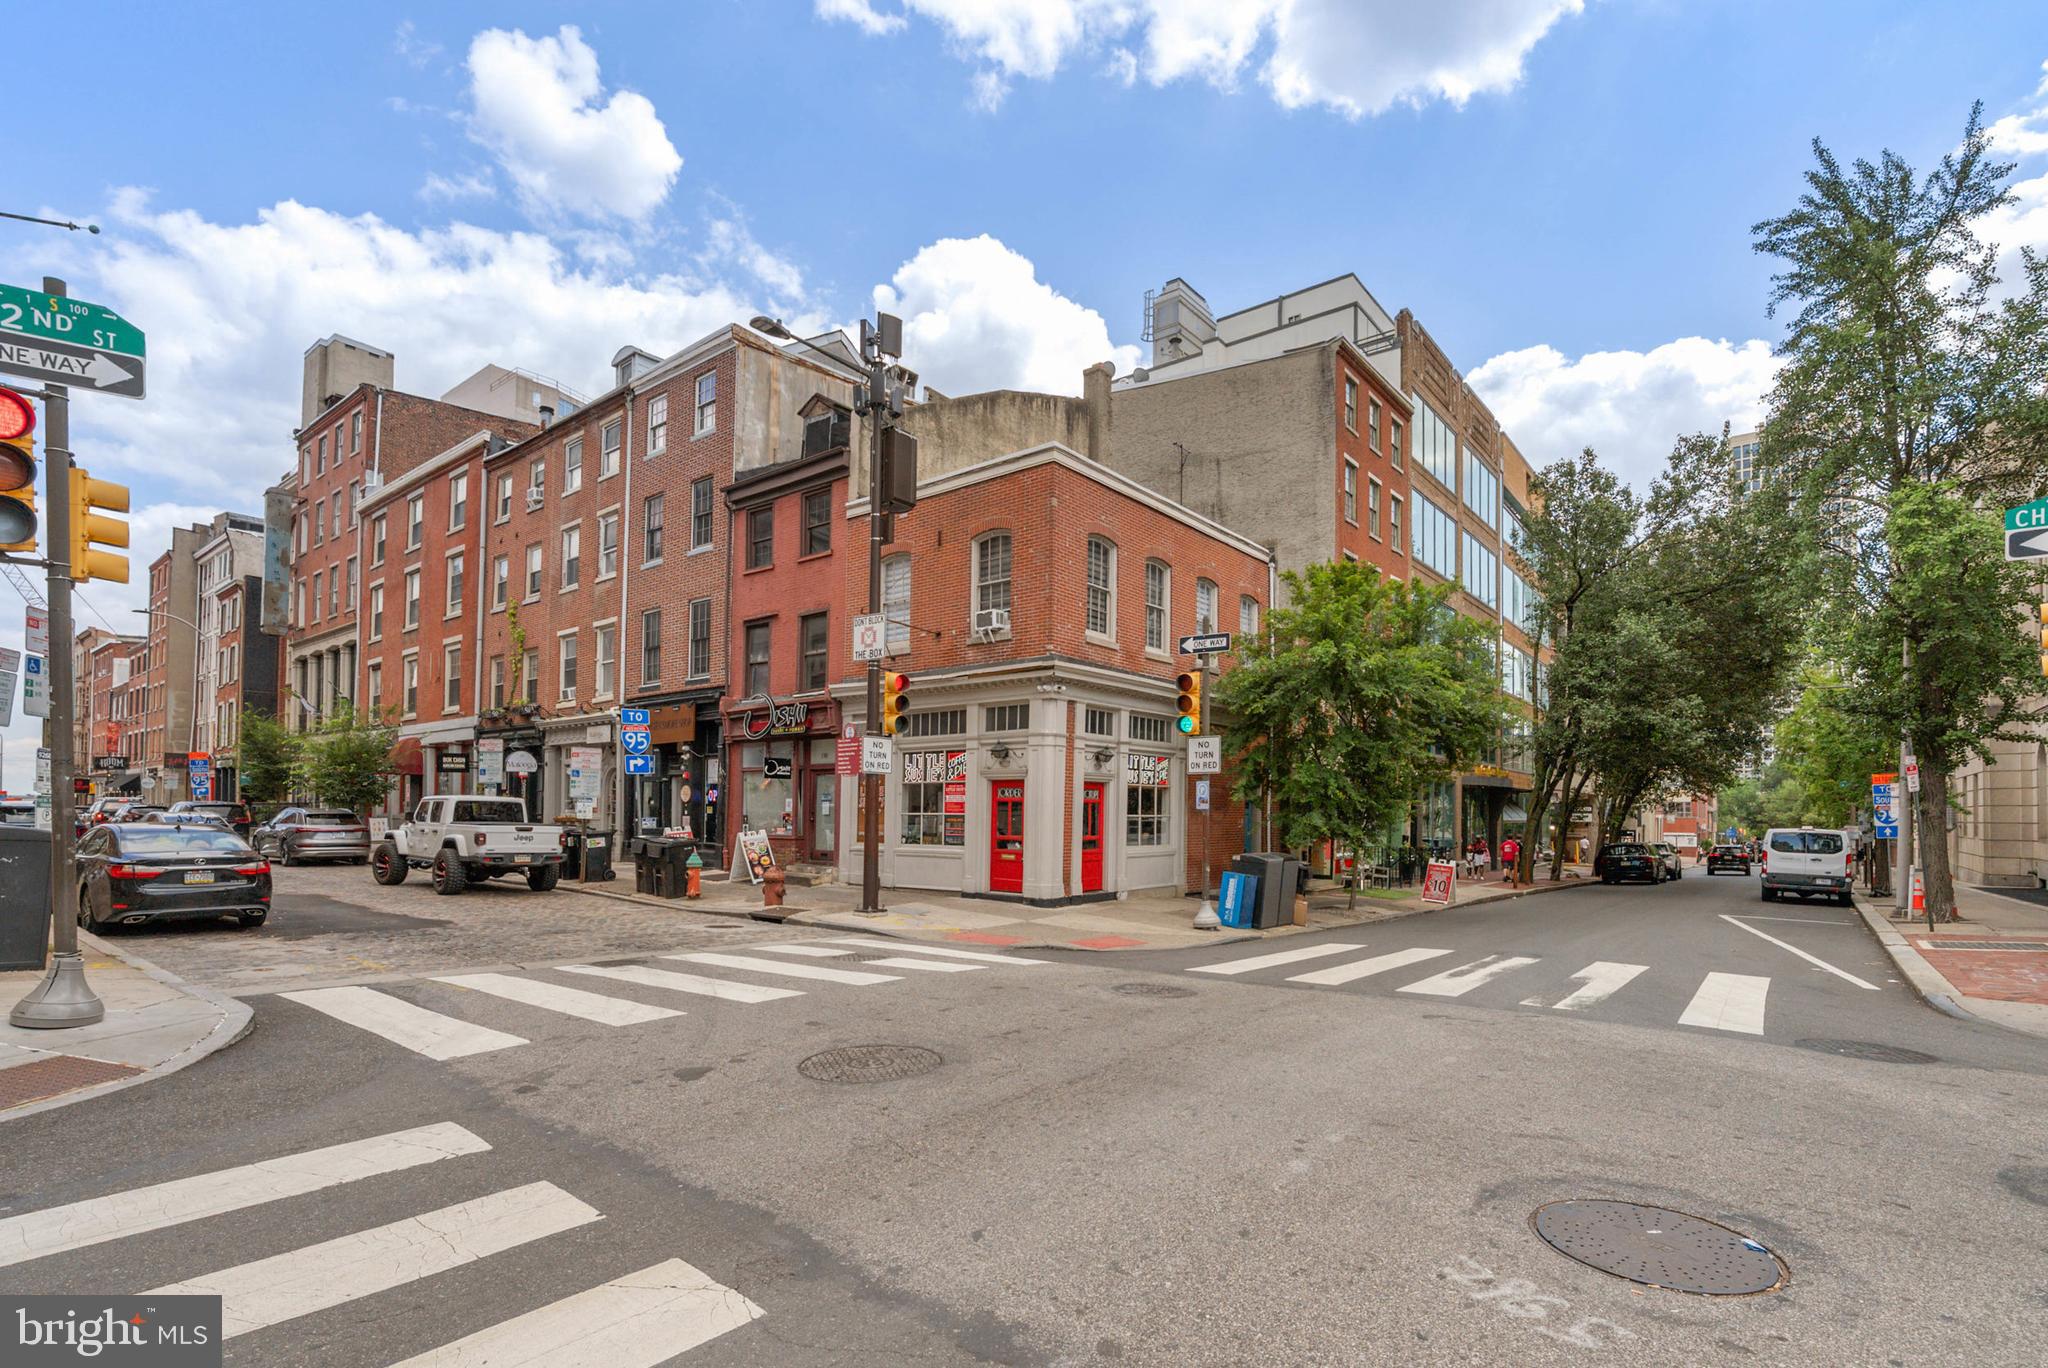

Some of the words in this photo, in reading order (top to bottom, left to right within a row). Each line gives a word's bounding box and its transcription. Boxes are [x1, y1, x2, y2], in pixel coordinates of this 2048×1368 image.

[49, 297, 58, 311] S
[69, 303, 89, 316] 100
[1, 302, 73, 332] 2ND
[93, 329, 116, 349] ST
[0, 345, 30, 365] NE
[40, 351, 92, 375] WAY
[2015, 507, 2046, 527] CH
[1194, 640, 1207, 648] ONE
[1210, 638, 1224, 646] WAY
[855, 650, 867, 659] THE
[869, 648, 883, 658] BOX
[628, 711, 643, 721] TO
[625, 732, 648, 749] 95
[872, 741, 884, 749] NO
[1198, 741, 1210, 749] NO
[869, 751, 887, 759] TURN
[1194, 751, 1214, 759] TURN
[865, 761, 875, 769] ON
[877, 761, 890, 769] RED
[1203, 761, 1217, 769] RED
[193, 776, 208, 785] 95
[708, 790, 718, 801] OP
[1877, 811, 1888, 821] 9
[1428, 880, 1447, 893] $10
